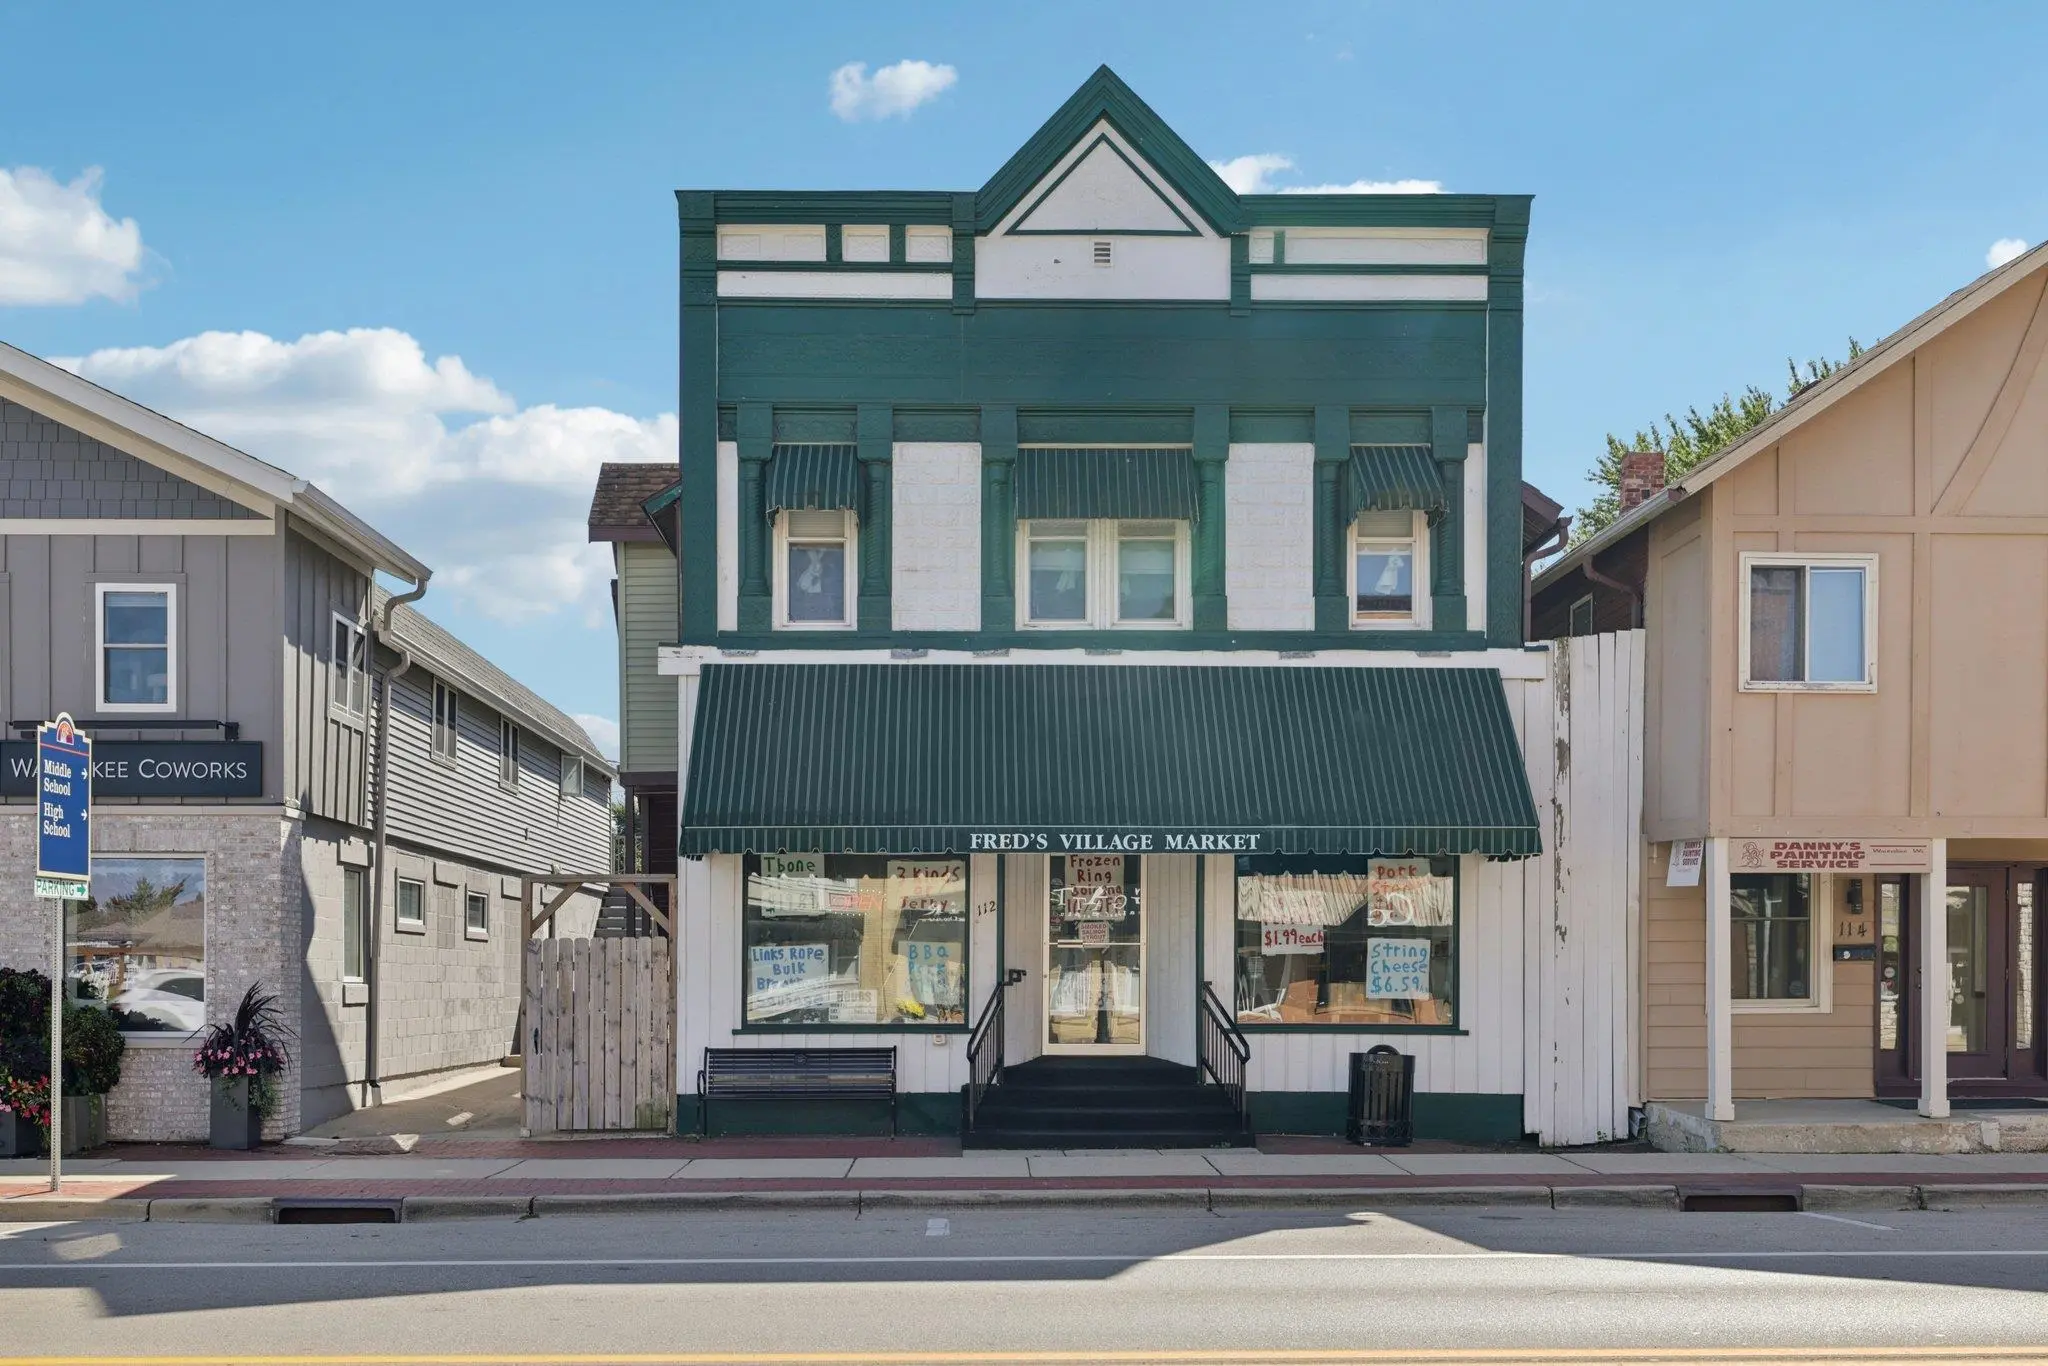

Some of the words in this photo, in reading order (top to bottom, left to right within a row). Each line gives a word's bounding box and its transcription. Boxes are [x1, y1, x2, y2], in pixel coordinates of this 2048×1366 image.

[43, 759, 72, 779] Middle
[139, 758, 248, 779] COWORKS
[43, 777, 72, 797] School
[43, 802, 64, 822] High
[43, 820, 71, 838] School
[970, 833, 1048, 849] FRED'S
[1059, 833, 1153, 850] VILLAGE
[1165, 833, 1260, 850] MARKET
[1774, 842, 1861, 850] DANNY'S
[1069, 854, 1121, 868] Frozen
[1770, 851, 1866, 860] PAINTING
[1776, 860, 1860, 869] SERVICE
[1077, 869, 1112, 884] Ring
[35, 879, 75, 896] PARKING
[977, 900, 996, 917] 112
[1839, 921, 1867, 937] 114
[1264, 928, 1298, 948] $1.99
[1298, 929, 1323, 945] each
[1371, 943, 1428, 963] String
[772, 962, 806, 975] Bulk
[1371, 959, 1428, 974] Cheese
